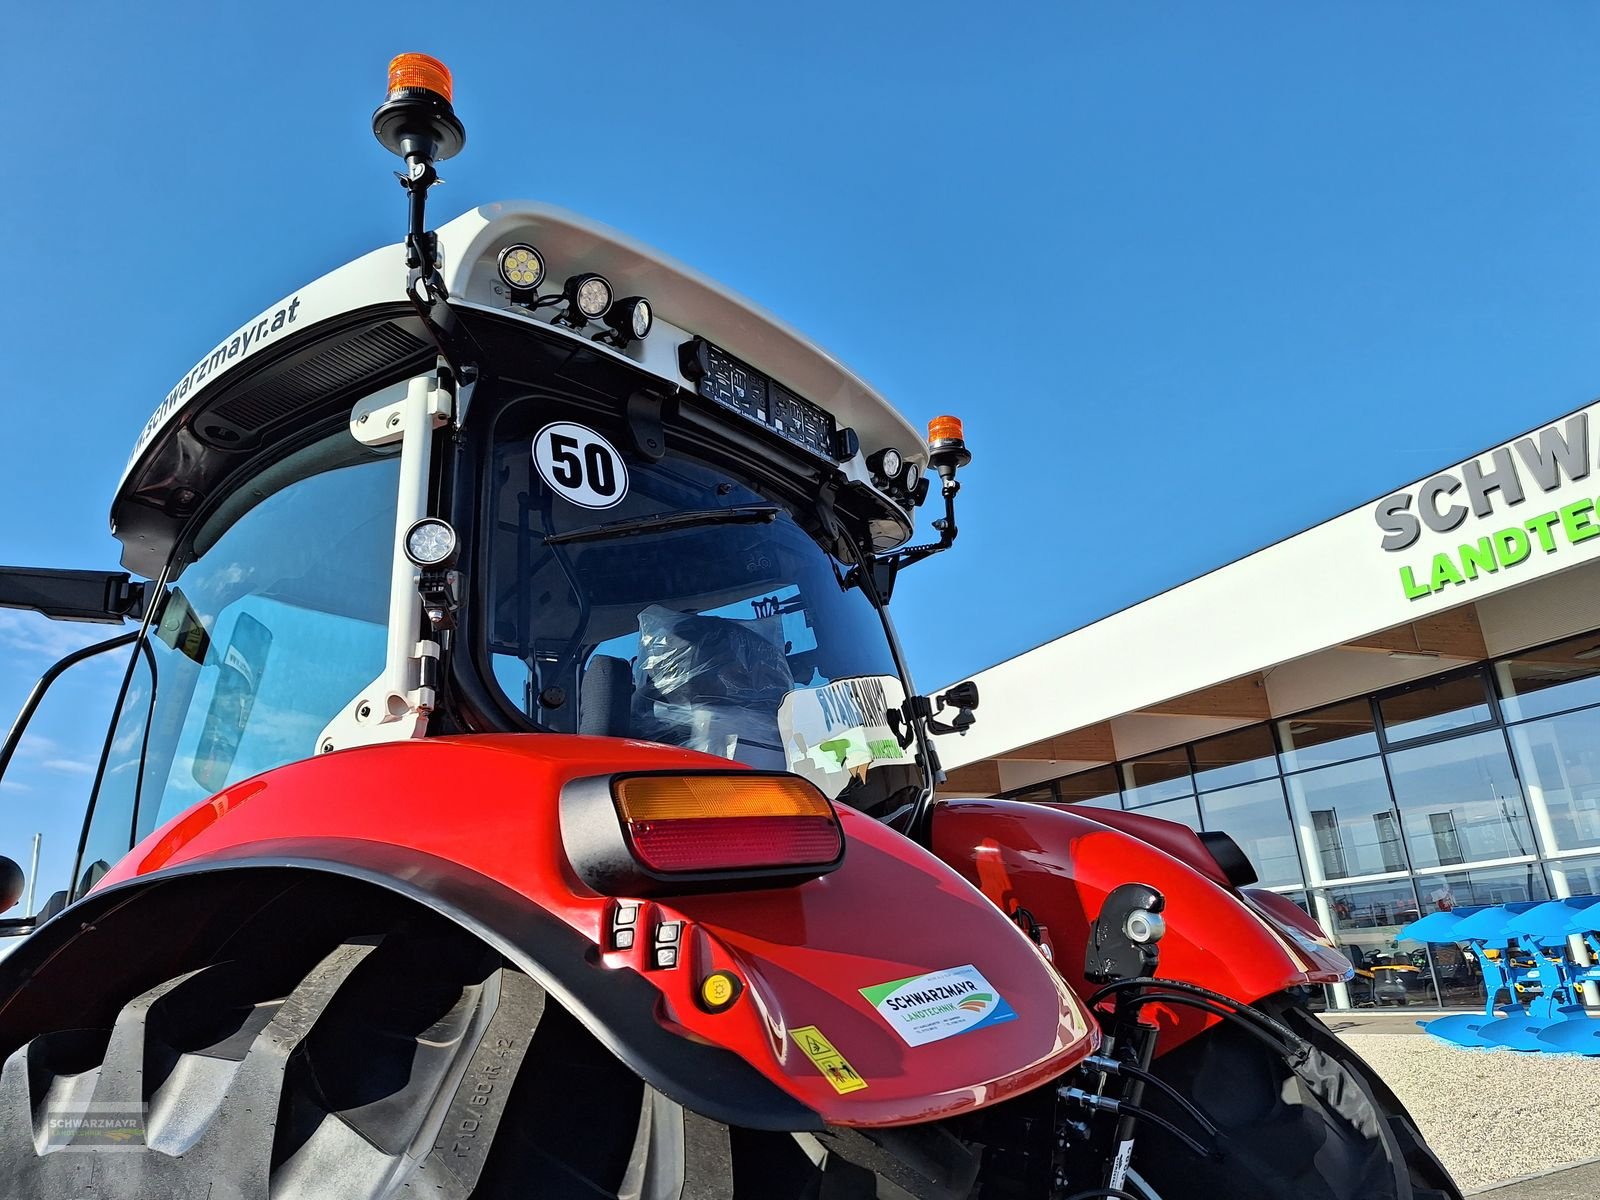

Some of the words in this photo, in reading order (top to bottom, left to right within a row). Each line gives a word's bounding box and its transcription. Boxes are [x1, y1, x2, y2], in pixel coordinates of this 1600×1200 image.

[550, 432, 616, 497] 50
[1375, 412, 1600, 552] SCHW
[1399, 495, 1600, 601] LANDTE
[886, 980, 978, 1011] SCHWARZMAYR
[902, 1002, 957, 1022] LANDTECHNIK
